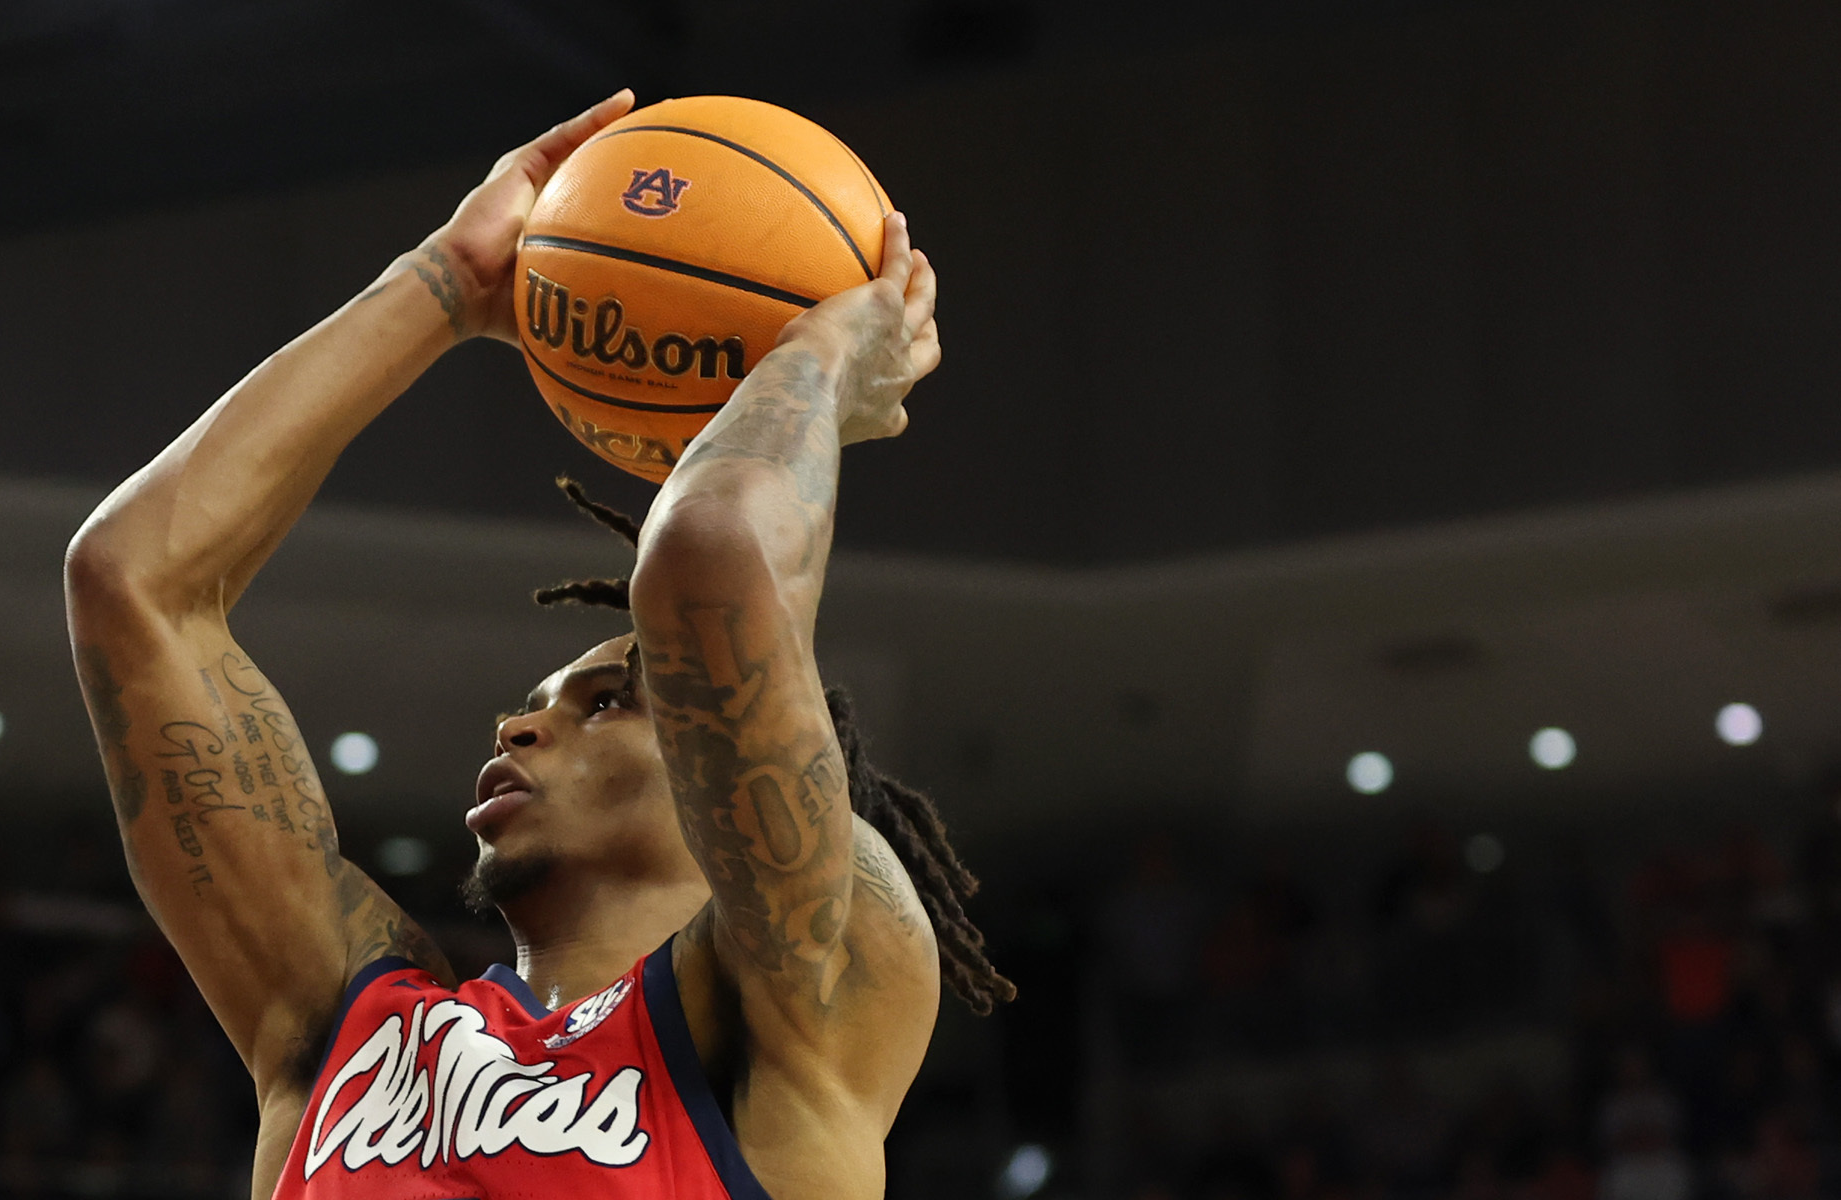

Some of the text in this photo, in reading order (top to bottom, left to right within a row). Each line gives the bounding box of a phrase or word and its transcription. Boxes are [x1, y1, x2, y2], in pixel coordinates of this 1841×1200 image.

[526, 267, 748, 381] Wilson
[566, 361, 679, 389] INDOOR GAME BALL
[556, 402, 694, 468] NCA
[154, 720, 246, 825] God
[161, 768, 184, 804] AND
[232, 750, 255, 796] WORD
[252, 804, 271, 823] OF
[237, 712, 296, 834] ARE THEY THAT
[172, 811, 204, 858] KEEP
[305, 998, 650, 1182] Ole Miss
